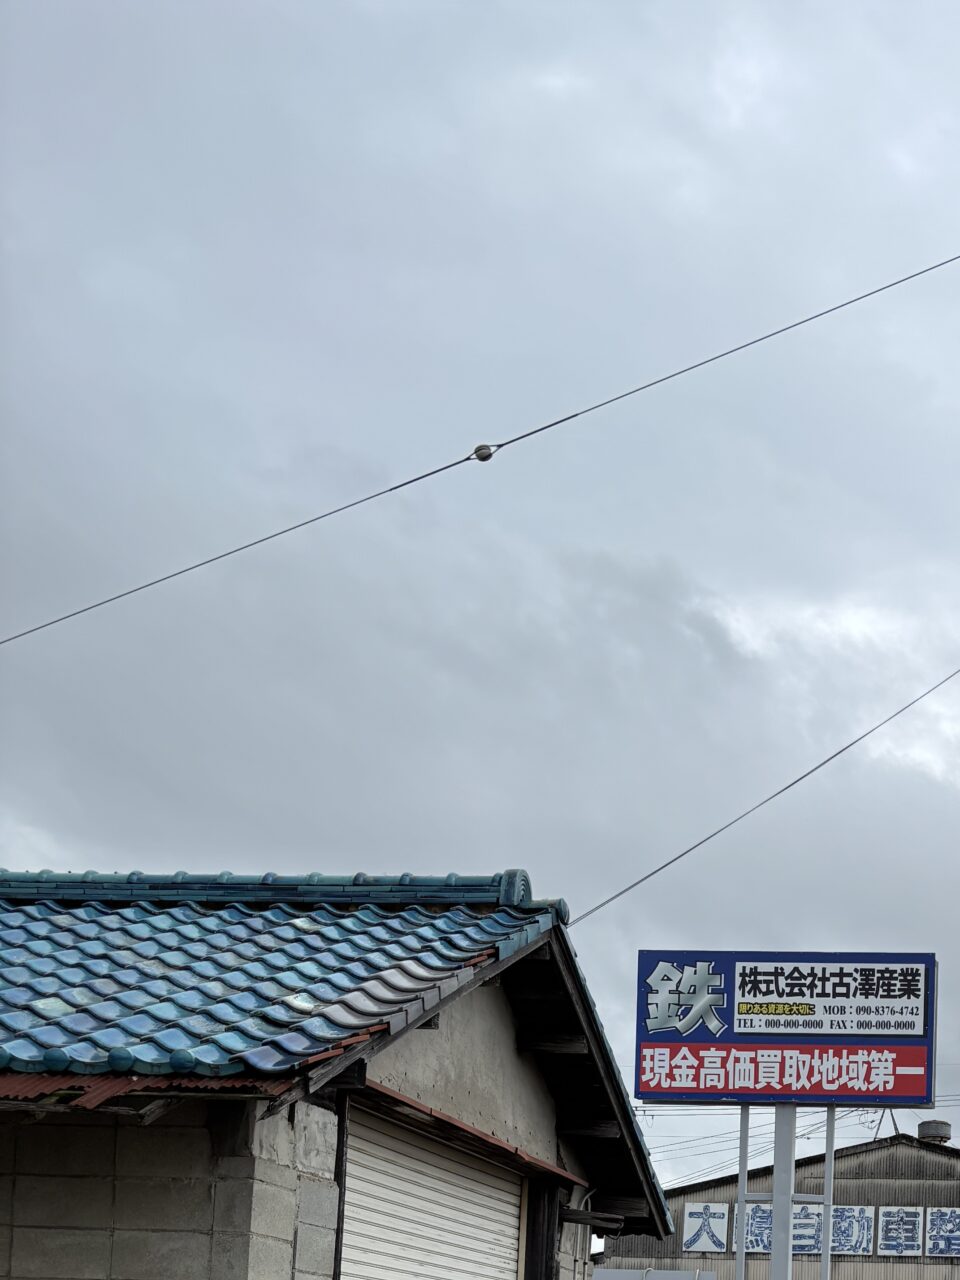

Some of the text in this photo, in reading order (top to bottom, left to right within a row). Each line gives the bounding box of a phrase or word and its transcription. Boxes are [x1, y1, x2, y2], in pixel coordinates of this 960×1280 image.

[645, 960, 729, 1038] 鉄
[738, 965, 922, 999] 株式会社古澤産業
[737, 1002, 816, 1016] 限りある資源を大切に
[641, 1046, 926, 1093] 現金高価買取地域第一
